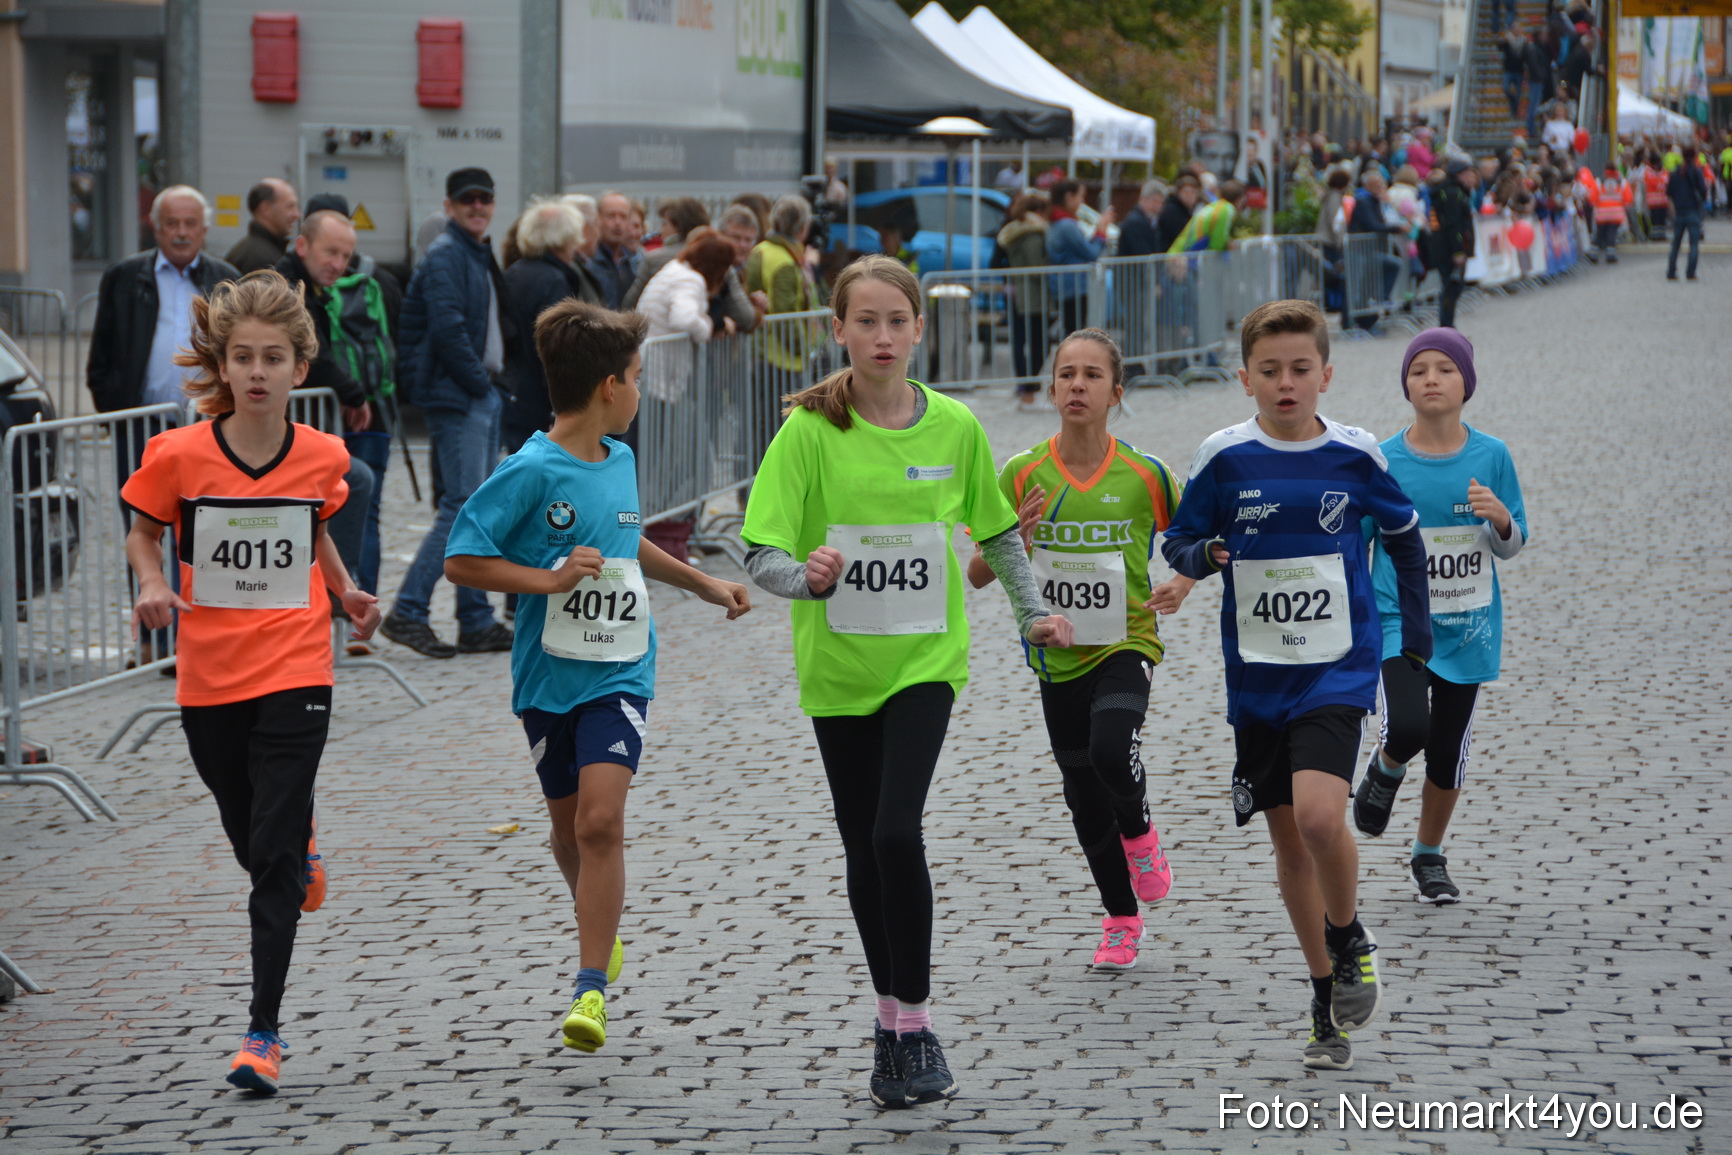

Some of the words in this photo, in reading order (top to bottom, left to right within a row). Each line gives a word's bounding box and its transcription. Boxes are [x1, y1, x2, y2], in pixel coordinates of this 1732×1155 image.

[1239, 489, 1261, 499] JAKO
[548, 502, 573, 513] BMW
[1326, 495, 1339, 511] FSV
[1453, 503, 1473, 514] BO
[240, 516, 279, 527] BOCK
[548, 533, 576, 542] PARTL
[1032, 519, 1133, 547] BOCK
[873, 534, 912, 545] BOCK
[211, 539, 293, 569] 4013
[1061, 561, 1096, 570] BOCK
[1427, 551, 1482, 580] 4009
[600, 567, 624, 577] OCK
[845, 558, 929, 592] 4043
[1276, 567, 1315, 578] BOCK
[235, 580, 268, 591] Marie
[1042, 579, 1111, 610] 4039
[1430, 586, 1476, 599] Magdalena
[563, 590, 637, 621] 4012
[1253, 589, 1332, 623] 4022
[1433, 615, 1473, 627] tadtlauf
[583, 631, 615, 643] Lukas
[1282, 634, 1306, 645] Nico
[608, 747, 628, 756] adidas
